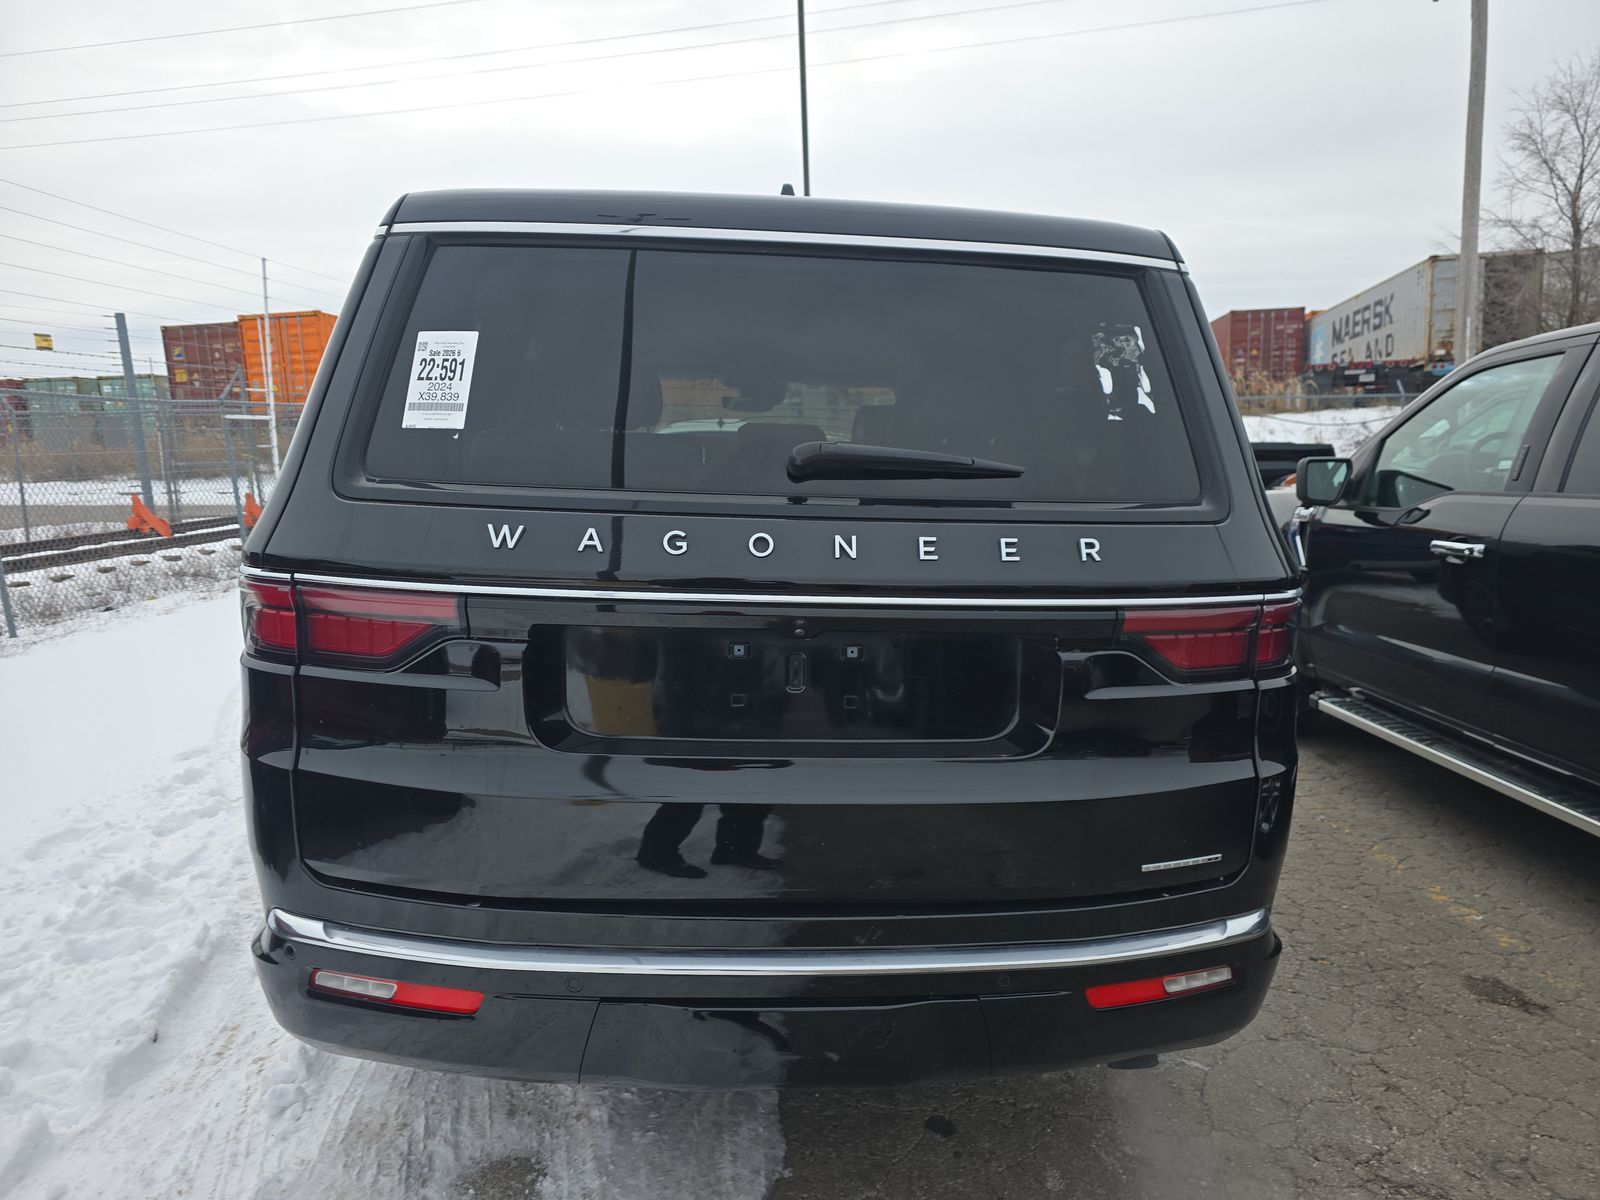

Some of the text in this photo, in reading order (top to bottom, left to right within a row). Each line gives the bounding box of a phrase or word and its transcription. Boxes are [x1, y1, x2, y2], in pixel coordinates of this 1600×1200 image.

[1331, 292, 1394, 348] MAERSK
[417, 358, 466, 381] 22:591
[427, 382, 452, 391] 2024
[487, 523, 1102, 562] WAGONEER
